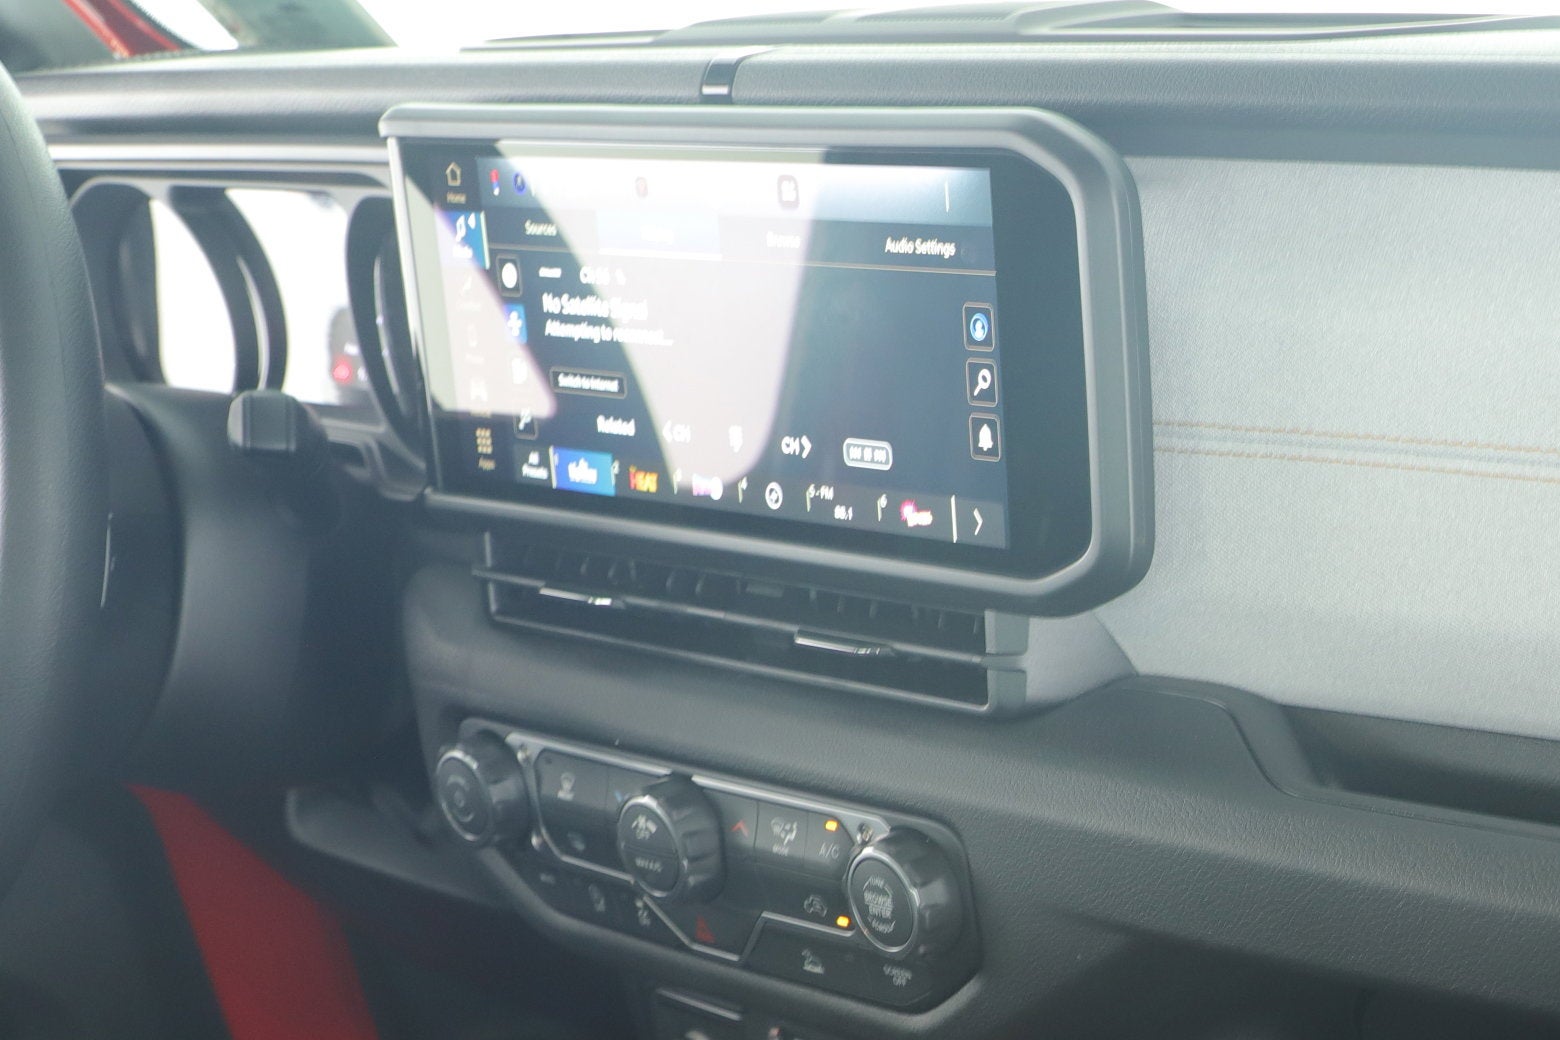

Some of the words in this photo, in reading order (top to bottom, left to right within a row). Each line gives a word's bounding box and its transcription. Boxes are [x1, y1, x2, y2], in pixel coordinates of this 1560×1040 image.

[525, 219, 557, 238] Sources
[885, 237, 914, 255] Audio
[915, 238, 956, 259] Settings
[542, 292, 560, 314] No
[561, 293, 609, 318] Satellite
[545, 319, 600, 344] Attempting
[601, 325, 612, 342] to
[596, 415, 636, 437] Related
[781, 435, 800, 455] CH
[820, 485, 834, 501] FM
[818, 842, 840, 860] A/C
